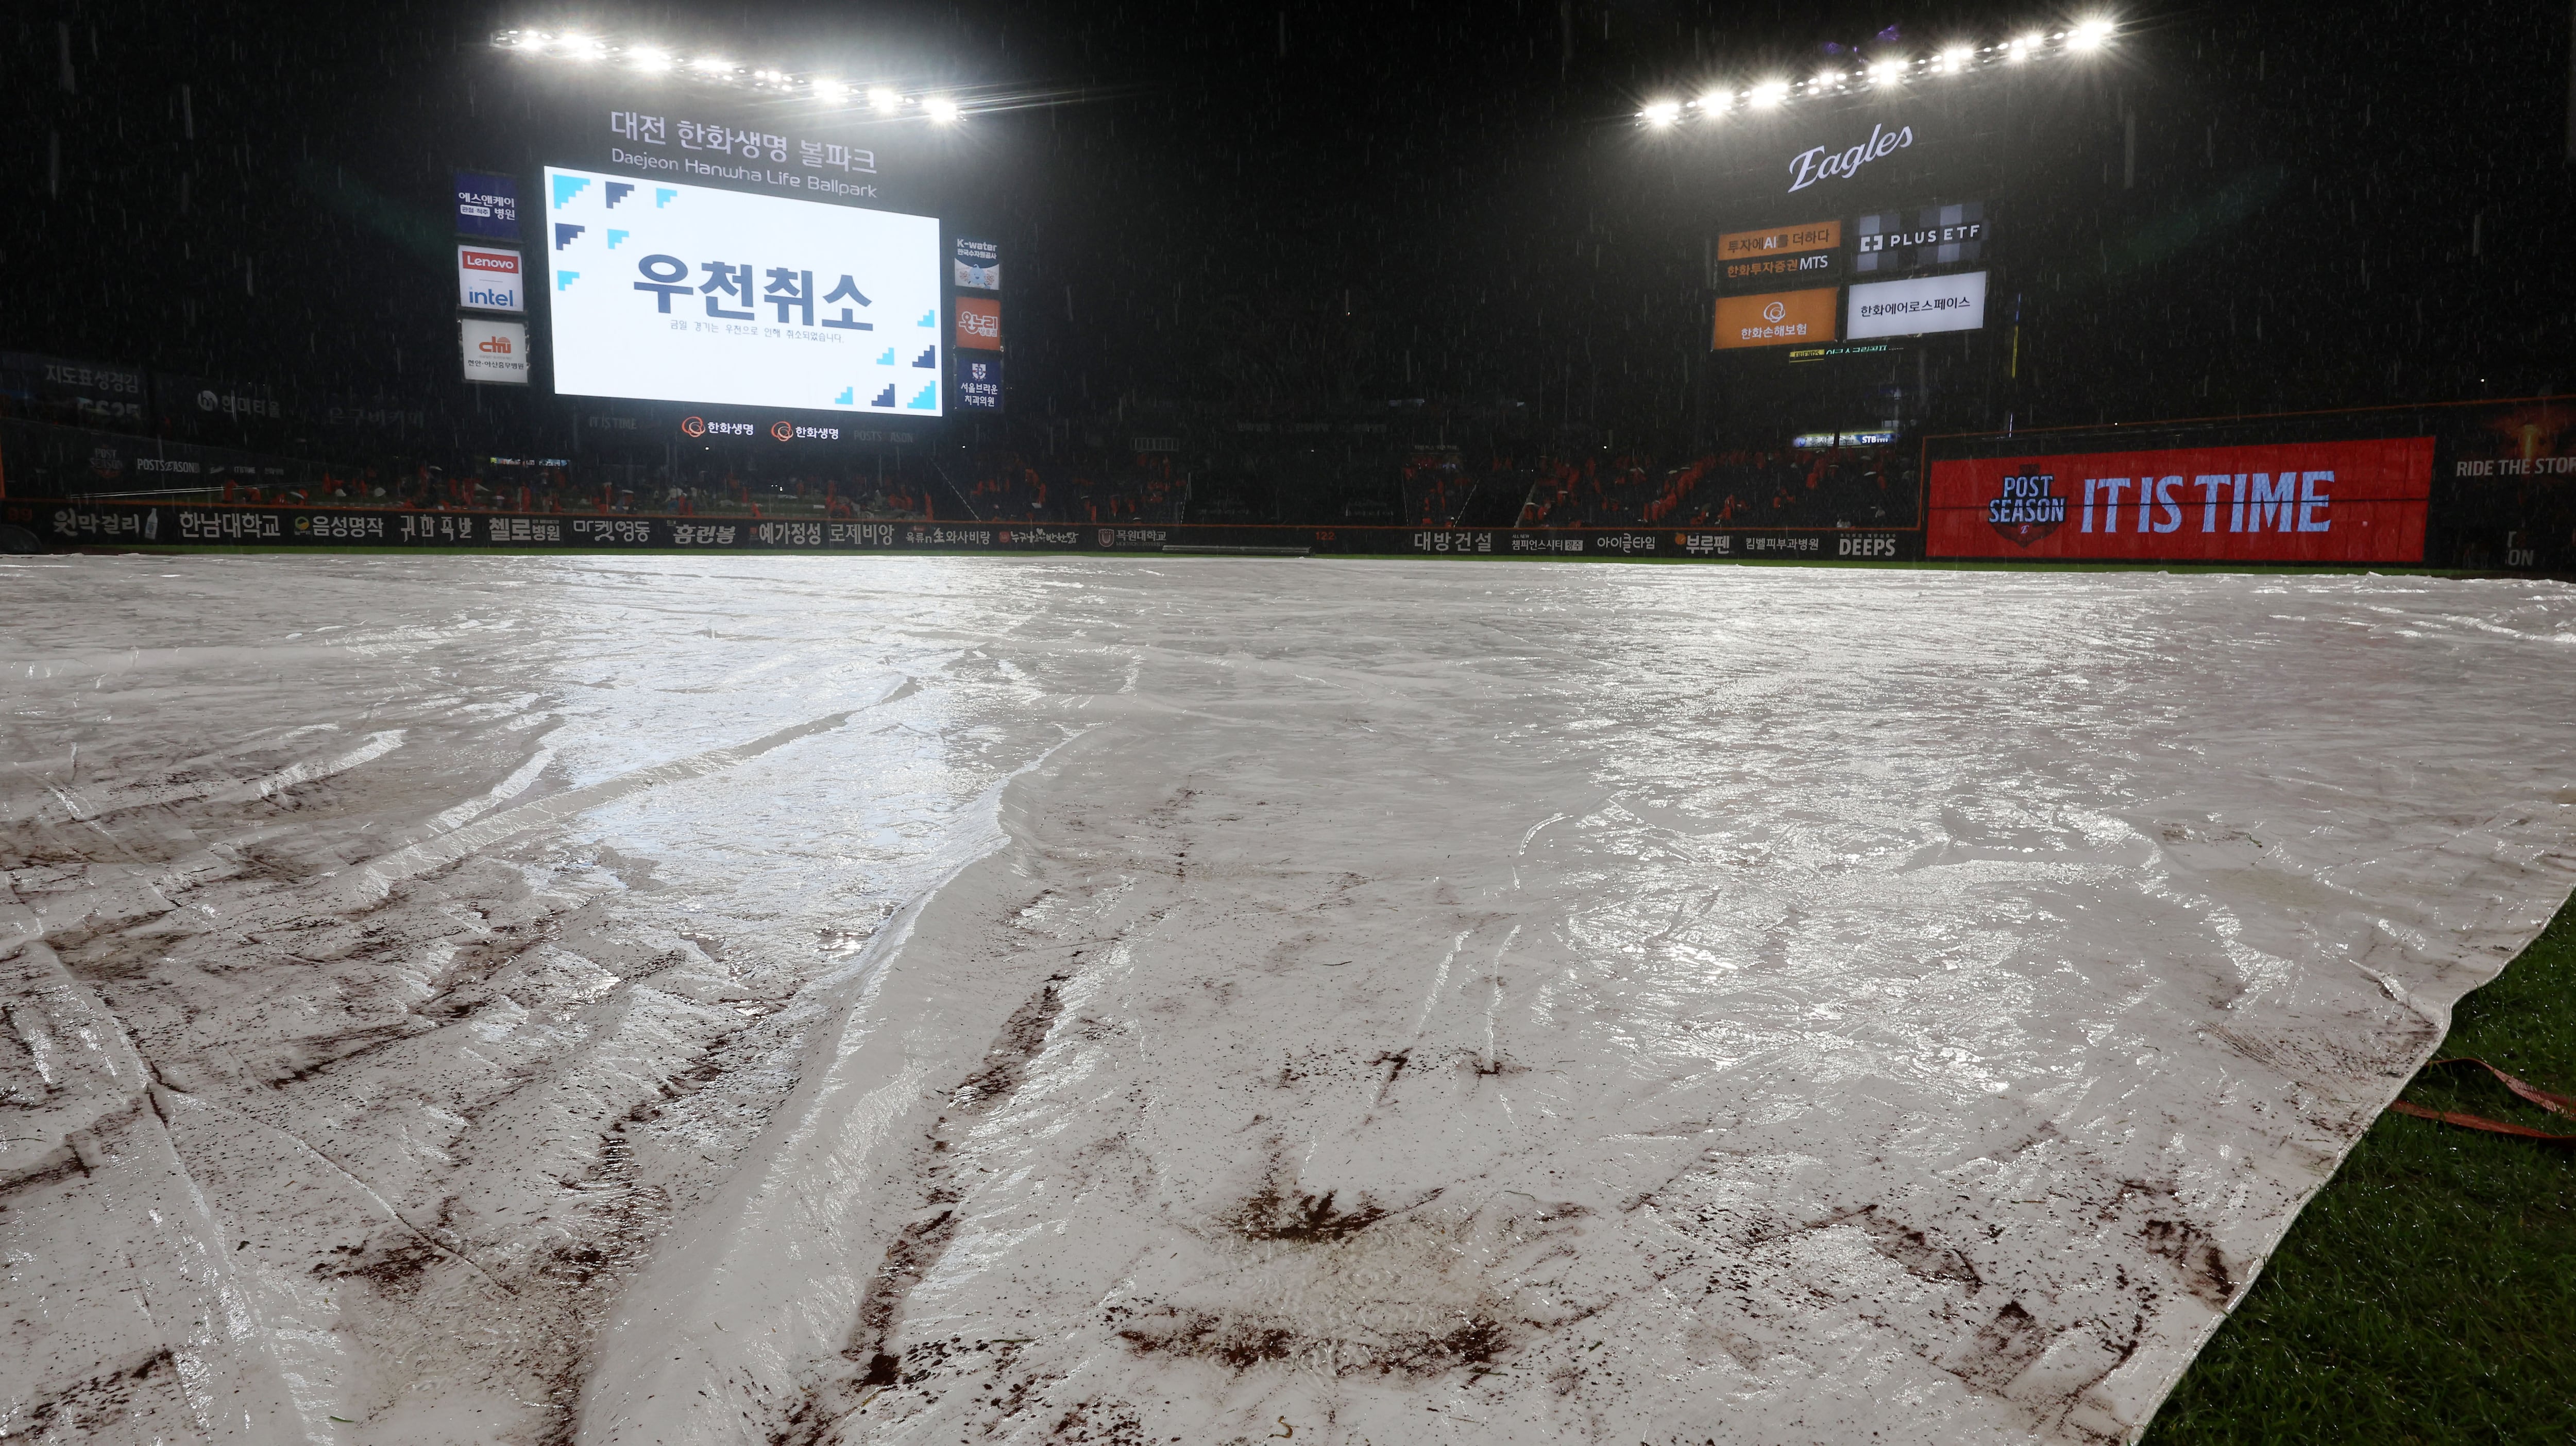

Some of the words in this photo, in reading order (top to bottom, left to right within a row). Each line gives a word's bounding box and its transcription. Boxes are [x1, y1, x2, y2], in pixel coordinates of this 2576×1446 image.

[611, 111, 666, 145] 대전
[676, 120, 787, 163] 한화생명
[799, 140, 877, 174] 볼파크
[1788, 123, 1913, 193] Eagles
[612, 148, 679, 171] Daejeon
[685, 158, 762, 182] Hanwha
[767, 171, 801, 187] Life
[807, 177, 878, 198] Ballpark
[459, 192, 515, 208] 에스앤케이
[494, 208, 515, 220] 병원
[957, 239, 997, 251] K-water
[1793, 229, 1829, 245] 더하다
[1890, 230, 1937, 247] PLUS
[1943, 225, 1980, 241] ETF
[467, 255, 514, 269] Lenovo
[957, 248, 997, 260] 한국수자원공사
[469, 286, 513, 307] intel
[634, 254, 873, 331] 우천취소
[1860, 296, 1971, 317] 한화에어로스페이스
[670, 319, 688, 330] 금일
[694, 321, 719, 333] 경기는
[725, 324, 759, 335] 우천으로
[764, 327, 781, 338] 인해
[958, 311, 998, 334] 온누리
[1741, 323, 1807, 340] 한화손해보험
[960, 382, 998, 395] 서울브라운
[964, 395, 995, 407] 치과의원
[707, 421, 754, 436] 한화생명
[795, 426, 839, 440] 한화생명
[1861, 435, 1877, 444] STB
[2456, 460, 2494, 477] RIDE
[2498, 458, 2532, 475] THE
[2003, 475, 2054, 498] POST
[1989, 498, 2065, 523] SEASON
[2080, 478, 2131, 533] IT
[2137, 475, 2183, 534] IS
[2194, 470, 2335, 533] TIME
[179, 511, 281, 538] 한남대학교
[312, 515, 384, 538] 음성명작
[573, 520, 650, 542] 마켓영동
[672, 524, 736, 544] 홈런볼
[759, 522, 821, 545] 예가정성
[829, 524, 895, 546] 로제비앙
[1116, 530, 1167, 541] 목원대학교
[1315, 531, 1335, 540] 122
[1414, 531, 1492, 552] 대방건설
[1597, 533, 1656, 553] 아이클타임
[1686, 535, 1731, 554] 부루펜
[1745, 537, 1819, 551] 킴벨피부과병원
[1566, 540, 1583, 550] 광주
[1839, 538, 1896, 556] DEEPS
